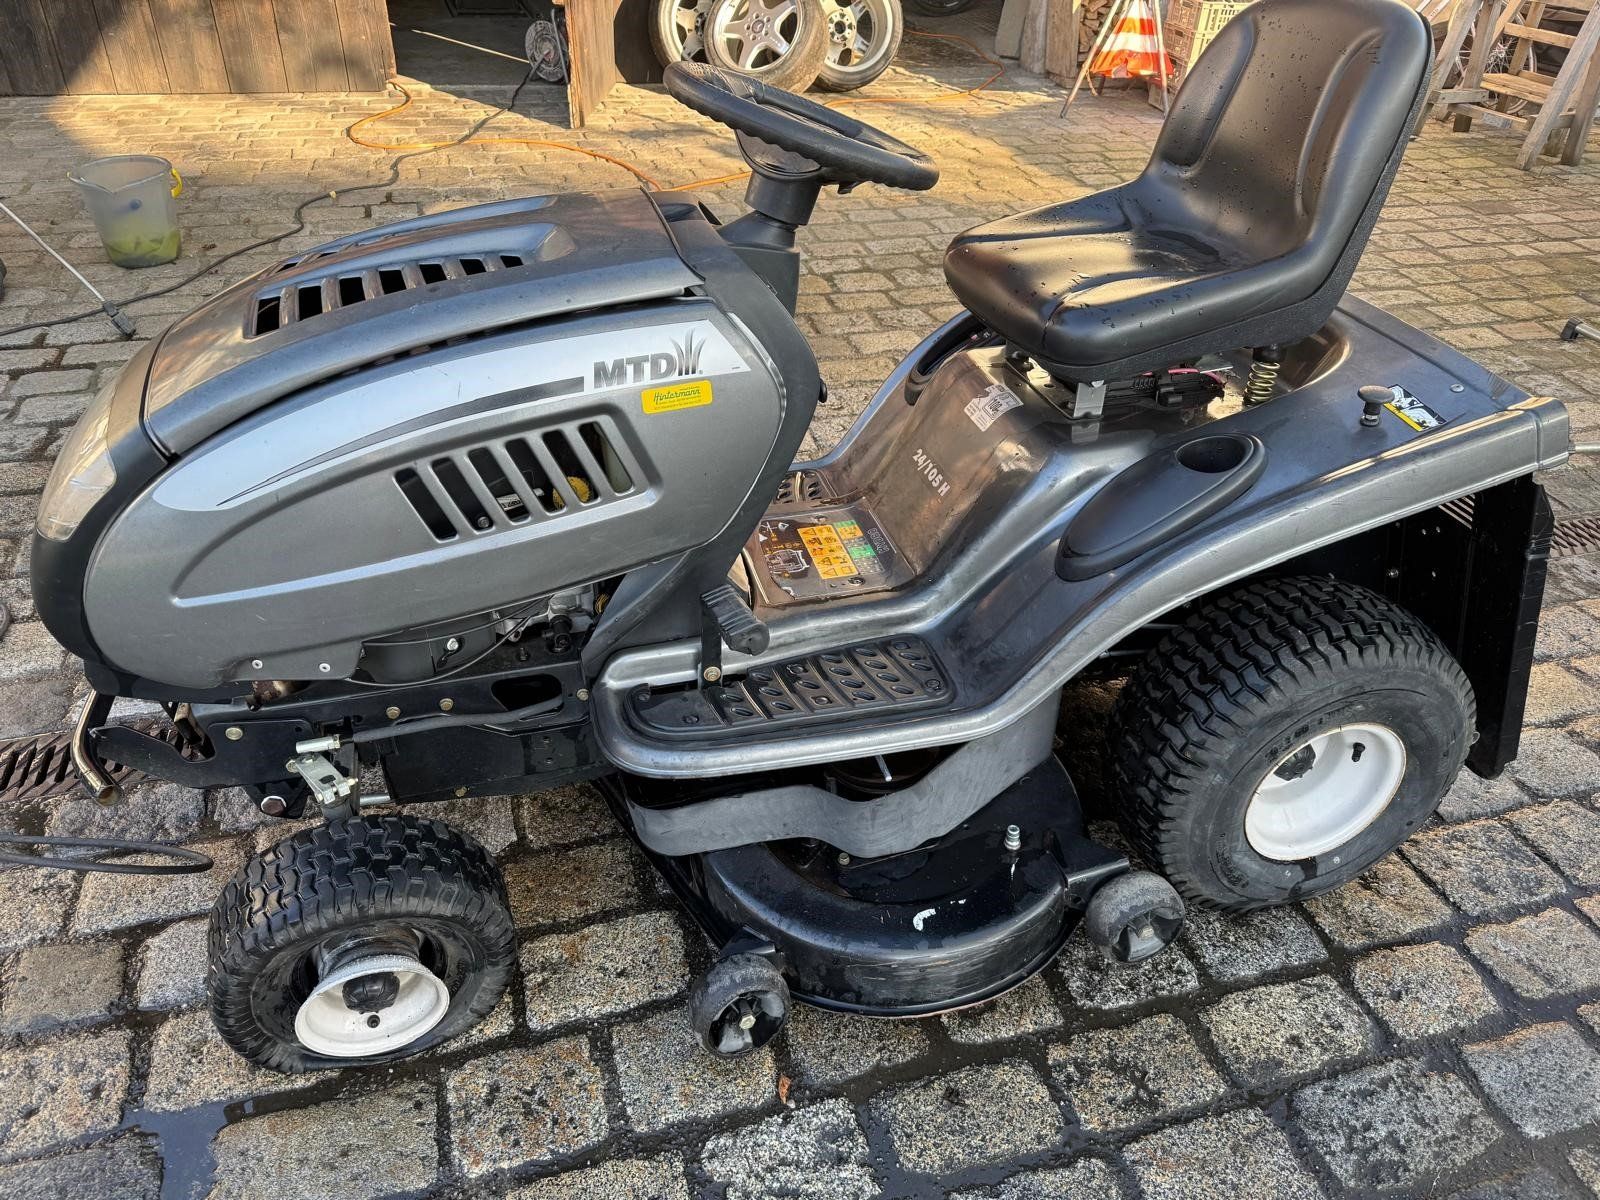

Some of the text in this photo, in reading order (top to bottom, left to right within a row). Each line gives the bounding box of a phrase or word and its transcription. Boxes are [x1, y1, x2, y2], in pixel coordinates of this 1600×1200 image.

[593, 353, 676, 389] MTD
[653, 388, 701, 405] Hintermann
[912, 448, 951, 497] 24/105 H
